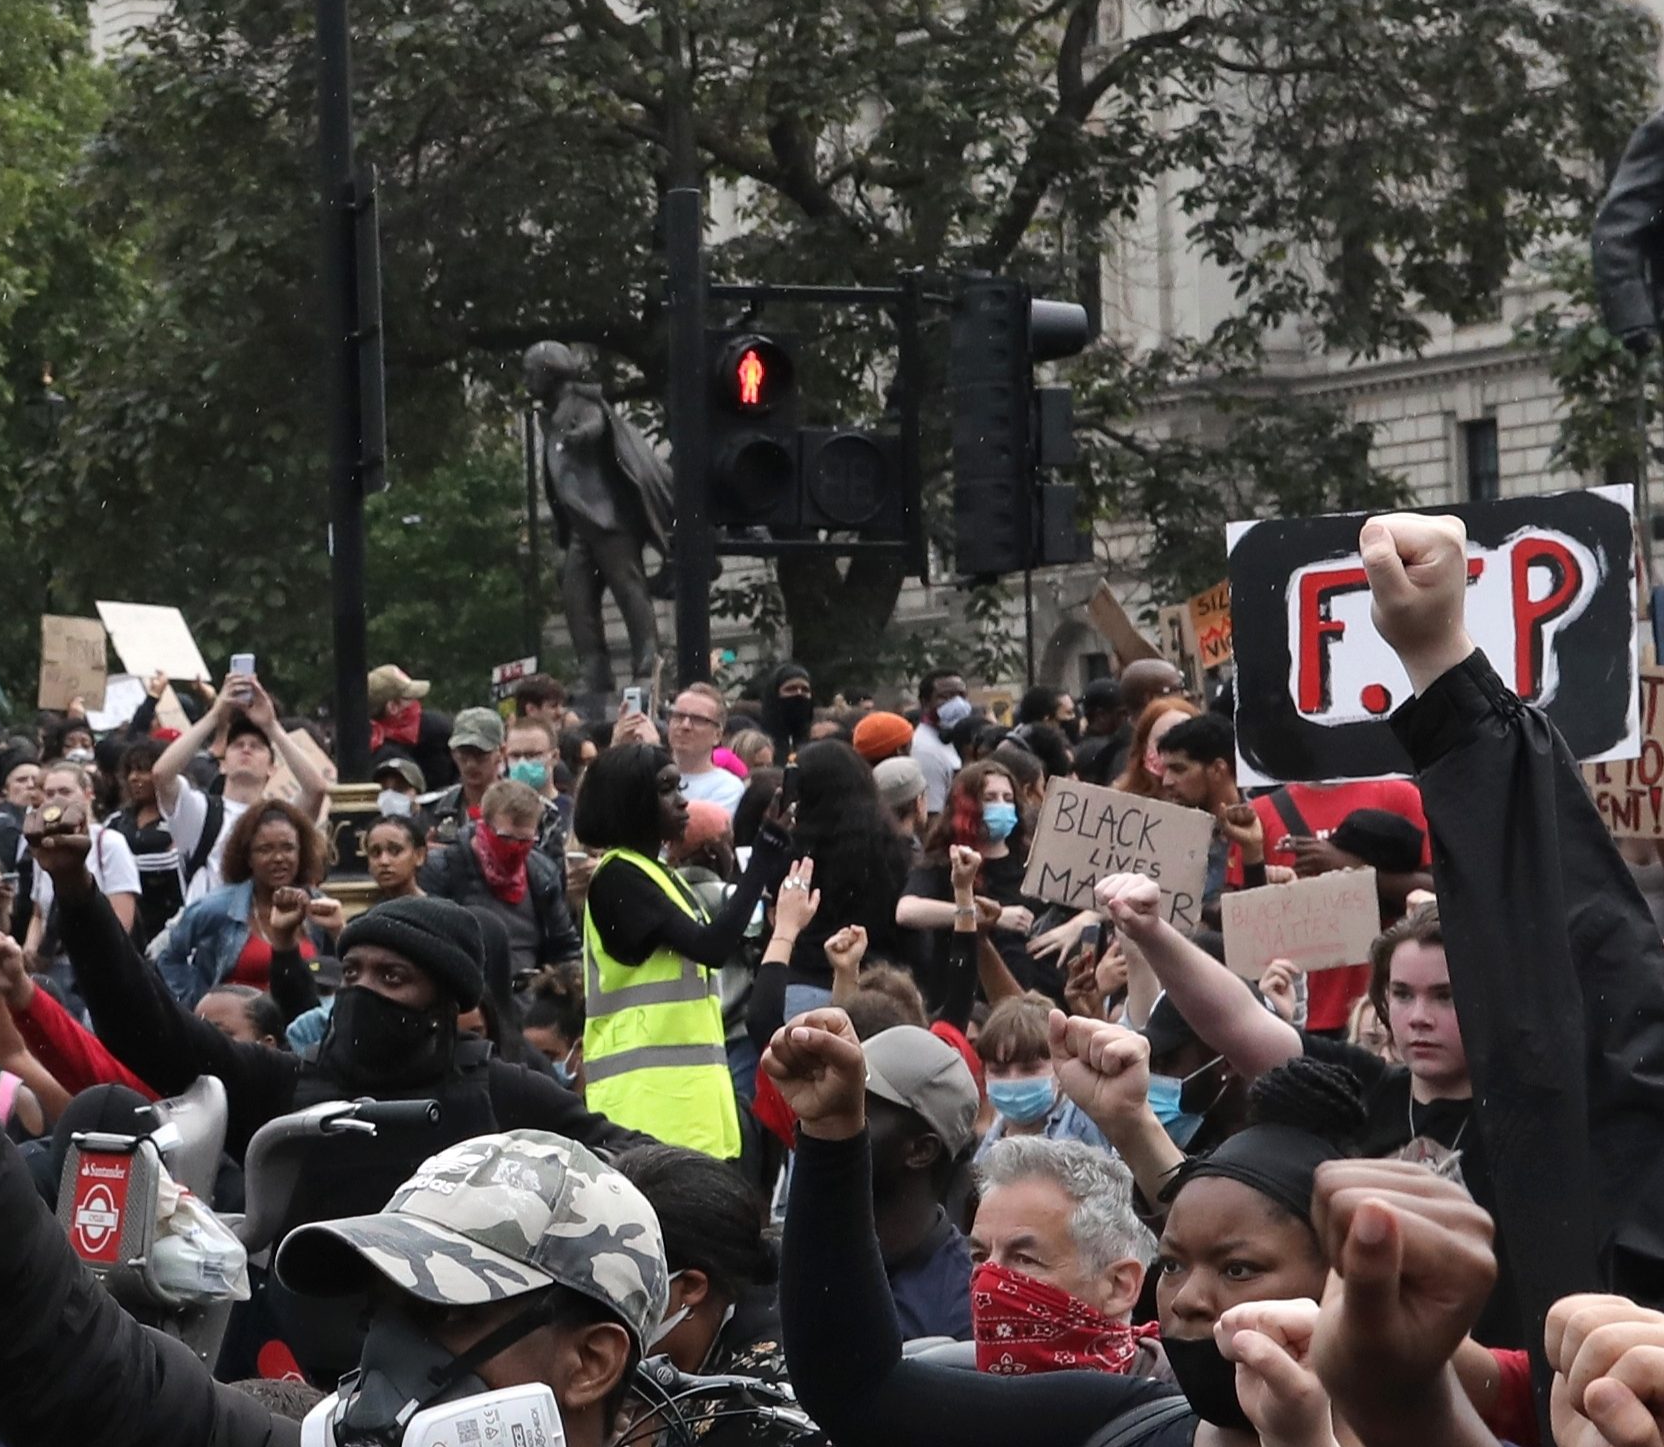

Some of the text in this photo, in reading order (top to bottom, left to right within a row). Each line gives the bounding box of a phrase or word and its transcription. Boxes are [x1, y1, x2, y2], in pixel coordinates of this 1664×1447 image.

[1054, 791, 1162, 853] BLACK
[1038, 862, 1194, 927] MAR
[1230, 891, 1368, 928] BLACK LIVES
[1252, 919, 1341, 948] MATTER
[90, 1162, 126, 1179] Santander
